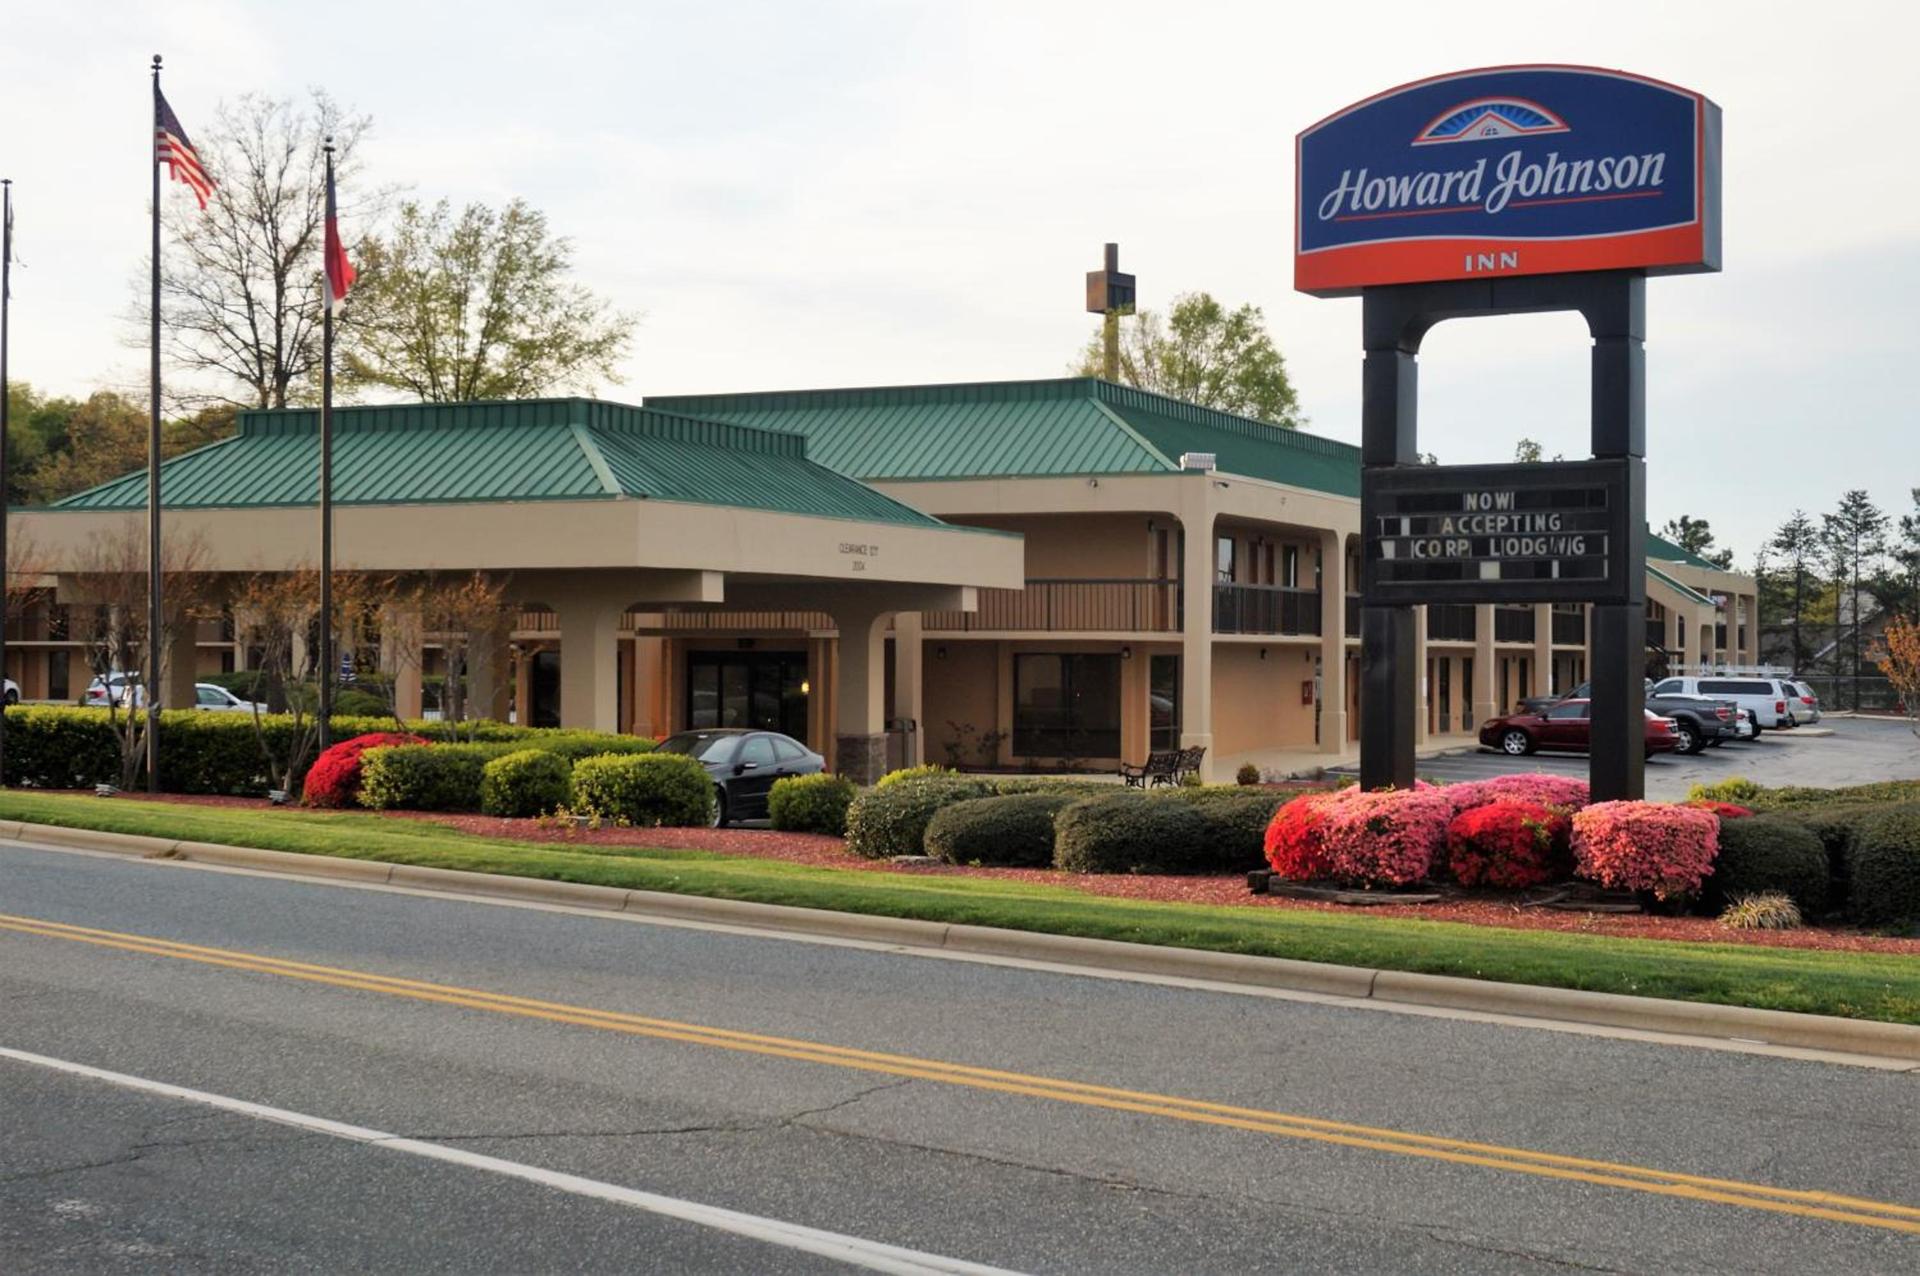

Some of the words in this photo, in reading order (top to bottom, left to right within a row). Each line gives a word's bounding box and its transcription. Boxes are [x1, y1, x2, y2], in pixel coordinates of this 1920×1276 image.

[1318, 158, 1487, 221] Howard
[1485, 150, 1666, 214] Johnson
[1465, 251, 1518, 272] INN
[1466, 492, 1510, 510] NOW
[1441, 514, 1562, 535] ACCEPTING
[1414, 539, 1470, 558] CORP
